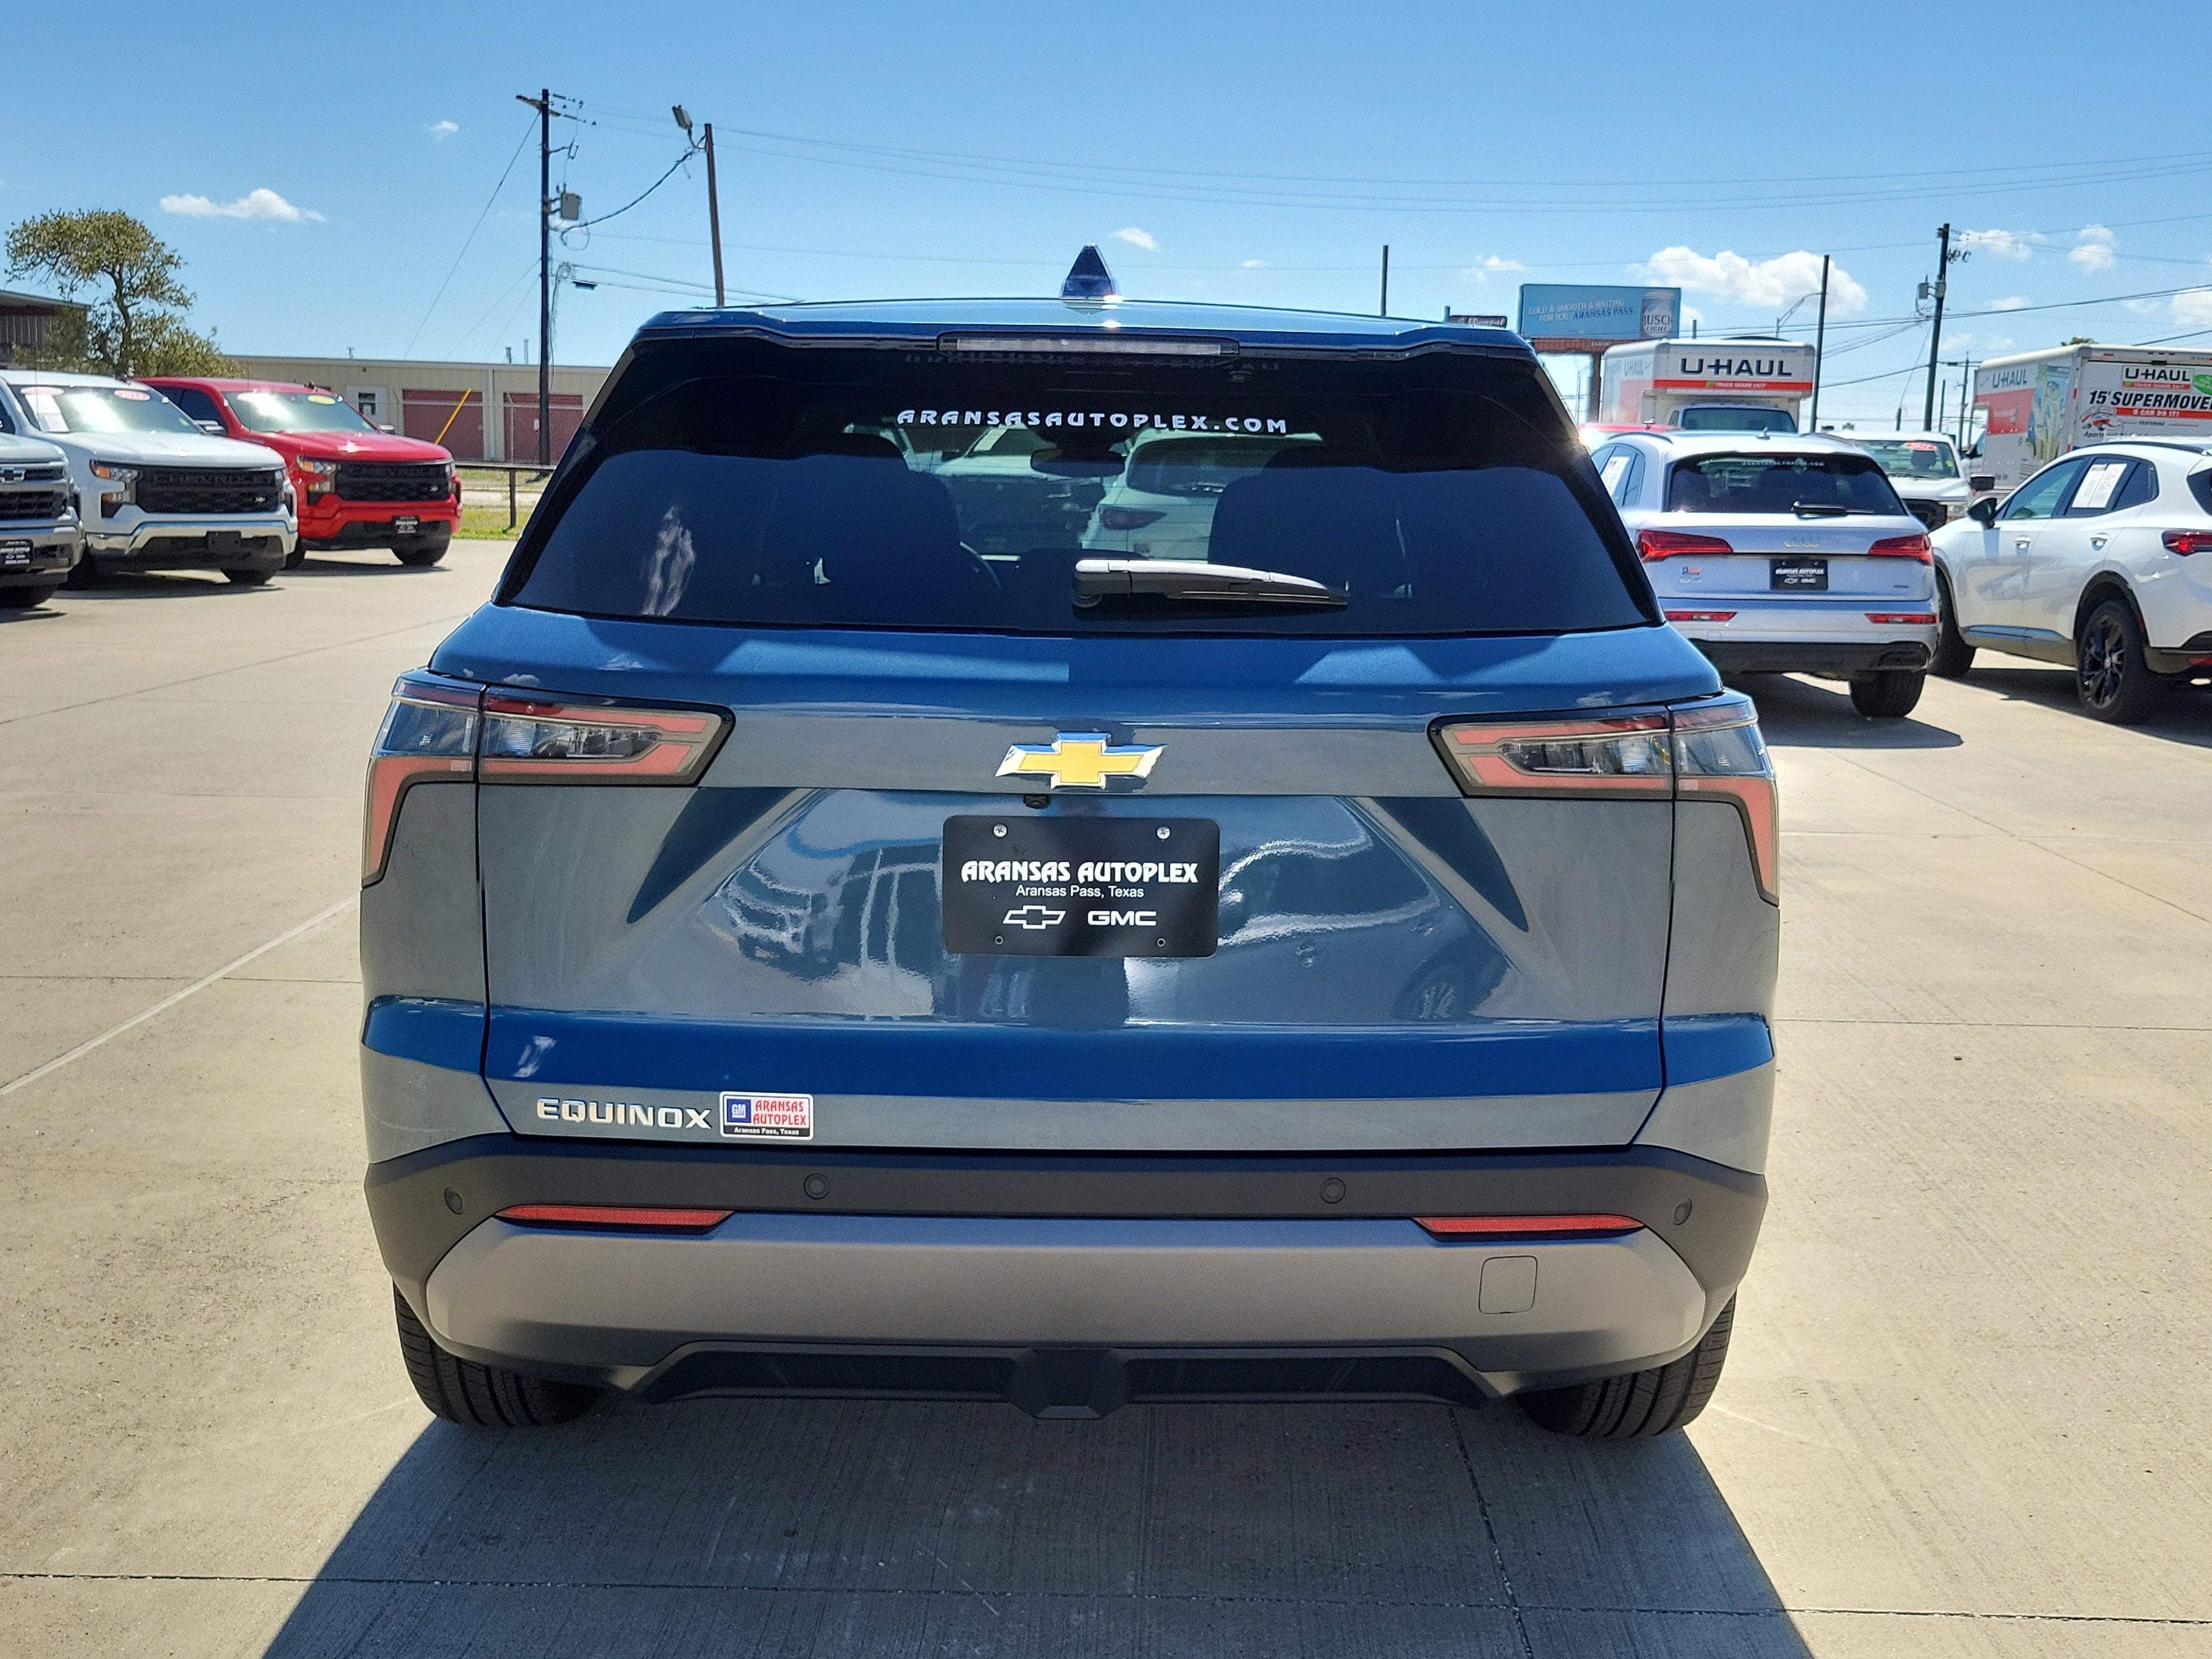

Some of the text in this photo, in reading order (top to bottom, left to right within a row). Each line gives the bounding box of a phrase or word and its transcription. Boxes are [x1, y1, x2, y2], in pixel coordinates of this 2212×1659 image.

[1680, 358, 1792, 377] U-HAUL
[2125, 368, 2190, 382] U-HAUL
[2111, 392, 2212, 410] SUPERMOVE
[897, 408, 1288, 434] ARANSASAUTOPLEX.COM
[961, 860, 1198, 883] ARANSAS AUTOPLEX
[1016, 885, 1144, 899] Aransas Pass, Texas
[1087, 911, 1157, 926] GMC
[537, 1097, 712, 1129] EQUINOX
[732, 1104, 746, 1115] GM
[755, 1100, 804, 1112] ARANSAS
[753, 1114, 806, 1125] AUTOPLEX
